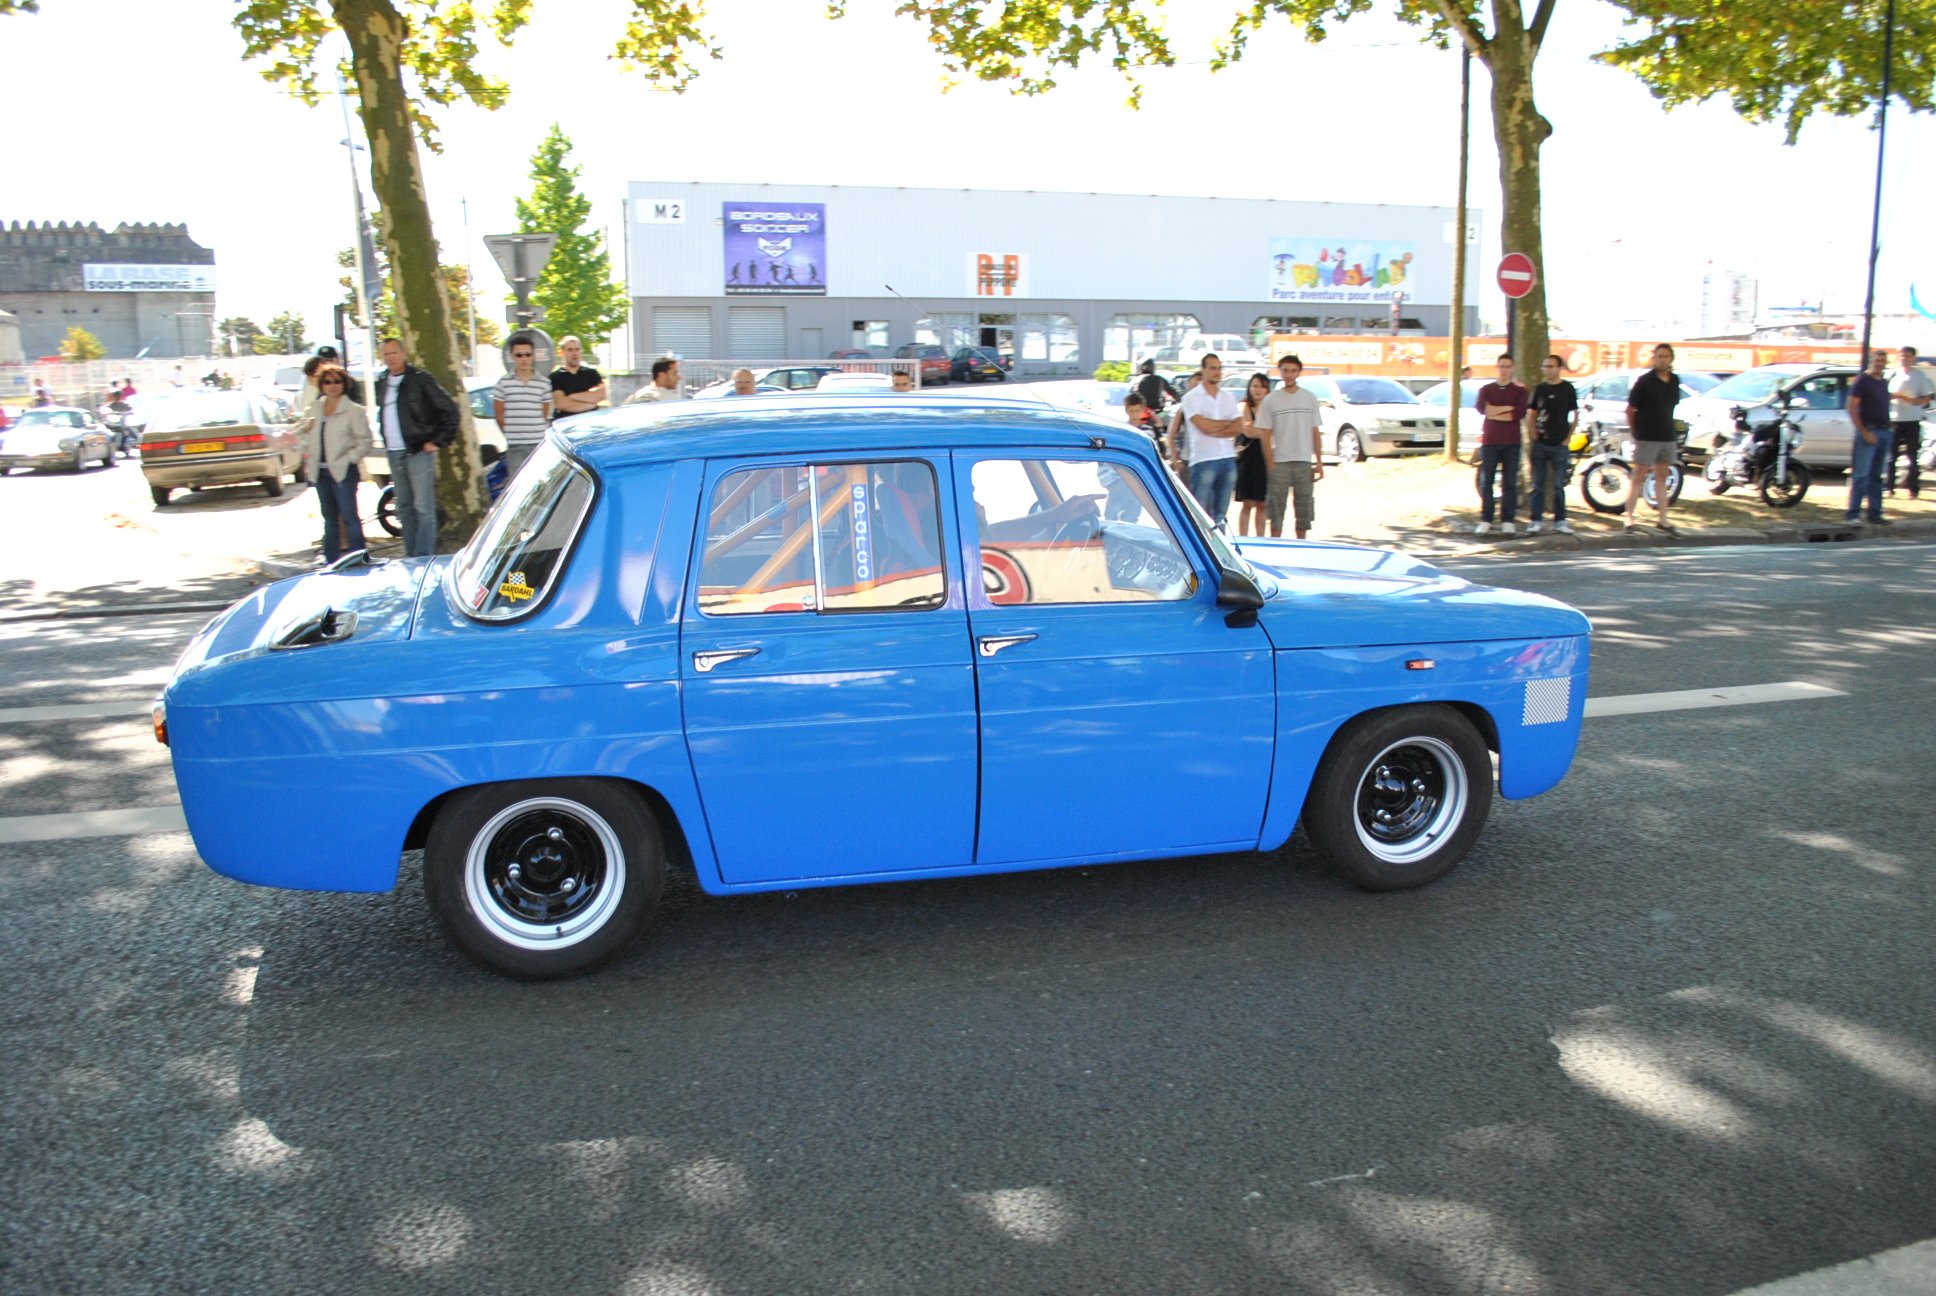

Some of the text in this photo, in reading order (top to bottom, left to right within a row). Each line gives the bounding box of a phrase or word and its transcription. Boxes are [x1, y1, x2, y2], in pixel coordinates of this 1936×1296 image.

[655, 204, 681, 219] M 2
[730, 211, 819, 221] BORDEAUX
[740, 223, 810, 234] SOCCER
[87, 267, 191, 280] LA BASE
[1272, 288, 1296, 299] Parc
[1299, 290, 1344, 300] aventure
[1347, 291, 1371, 301] pour
[852, 485, 869, 579] sparco
[501, 584, 533, 597] BARDAHL
